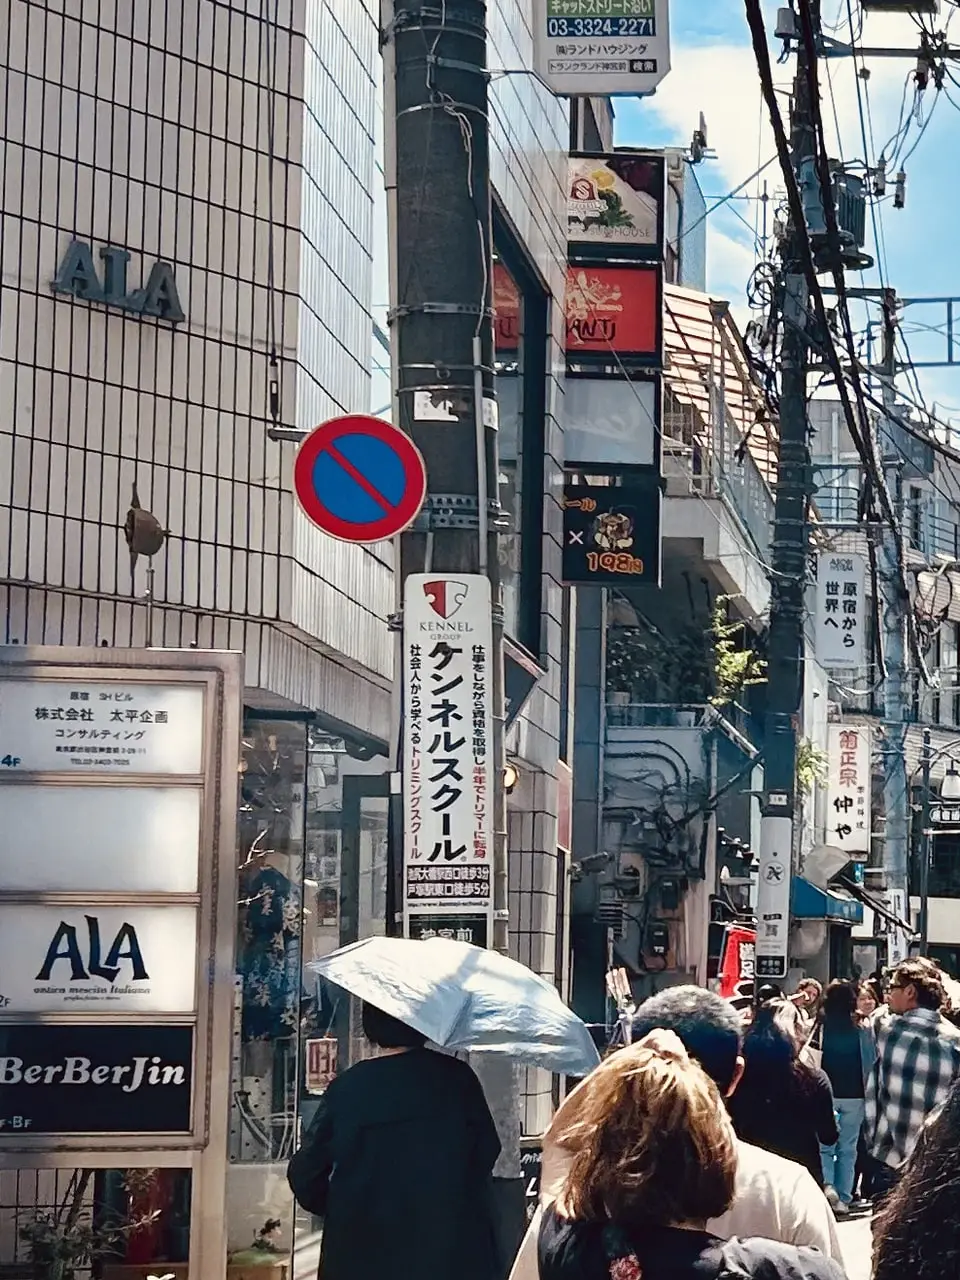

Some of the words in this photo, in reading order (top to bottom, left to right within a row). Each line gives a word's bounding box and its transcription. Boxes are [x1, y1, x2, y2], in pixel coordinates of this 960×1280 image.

[548, 18, 654, 36] 03-3324-2271
[49, 239, 187, 323] ALA
[823, 580, 839, 629] 世界へ
[841, 582, 858, 648] 原宿から
[419, 621, 471, 632] KENNEL
[35, 706, 94, 721] 株式会社
[110, 708, 169, 724] 太平企画
[55, 728, 147, 741] コンサルティング
[426, 640, 468, 863] ケンネルスクール
[1, 754, 21, 768] 4F
[35, 915, 150, 983] ALA
[0, 1056, 186, 1093] BerBerJin
